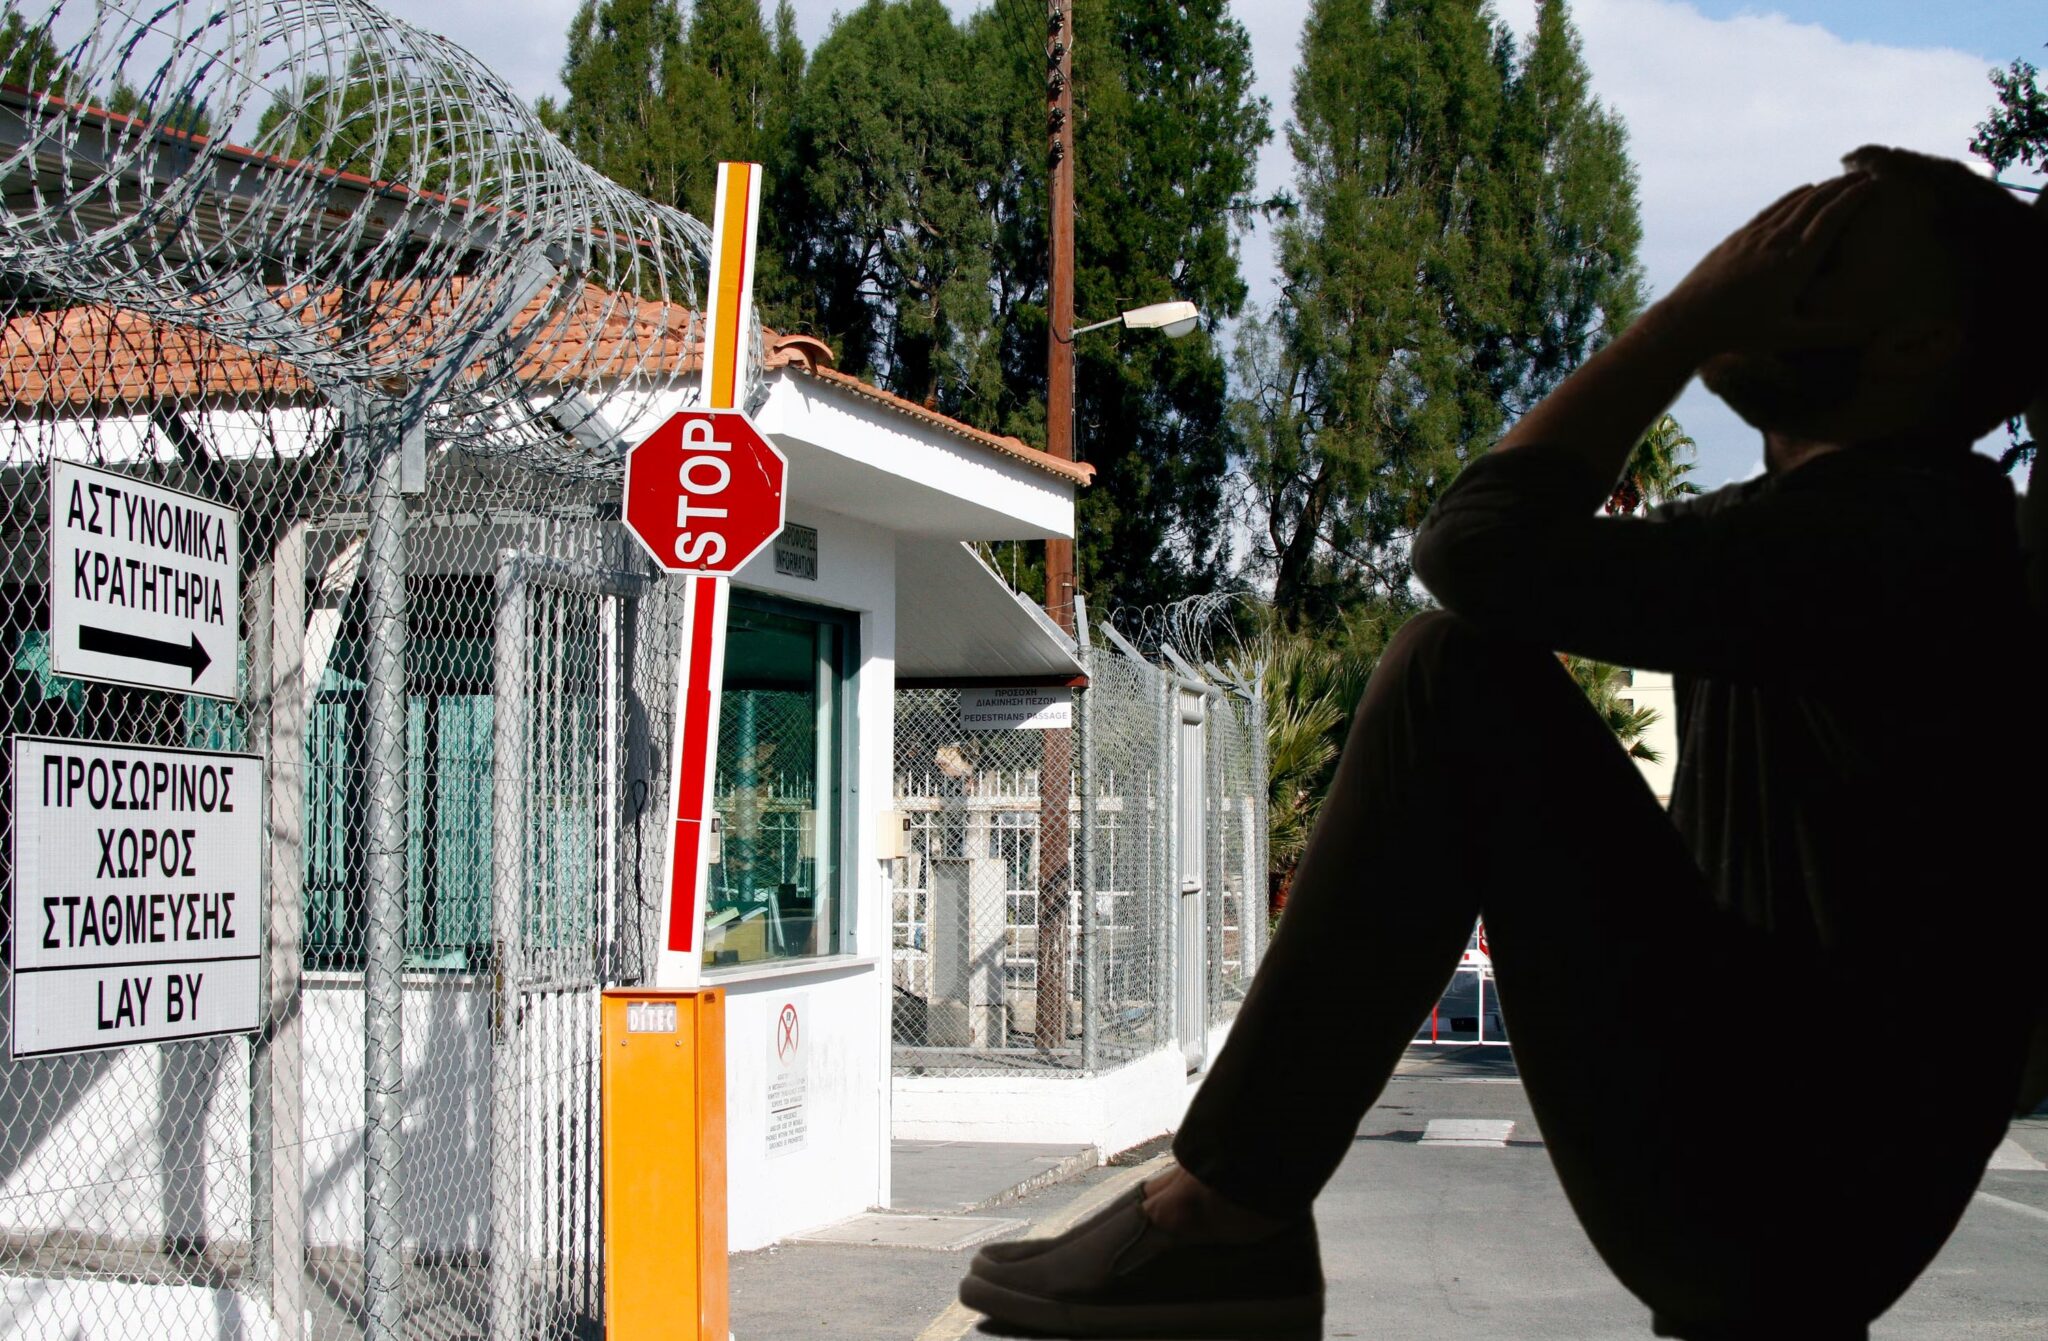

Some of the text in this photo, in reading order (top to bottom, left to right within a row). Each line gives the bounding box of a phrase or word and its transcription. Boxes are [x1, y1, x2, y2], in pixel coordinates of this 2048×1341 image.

[675, 419, 732, 565] STOP
[67, 479, 228, 565] ΑΣΤΥΝΟΜΙΚΑ
[75, 548, 224, 626] ΚΡΑΤΗΤΗΡΙΑ
[964, 711, 1068, 722] PEDESTRIANS PASSAGE
[976, 696, 1057, 707] ΔΙΑΚΙΝΗΣΗ ΠΕΖΩΝ
[995, 688, 1037, 697] ΠΡΟΣΟΧΗ
[43, 755, 234, 813] ΠΡΟΣΩΡΙΝΟΣ
[97, 828, 196, 879] ΧΩΡΟΣ
[43, 892, 235, 949] ΣΤΑΘΜΕΥΣΗΣ
[98, 973, 203, 1030] LAY BY
